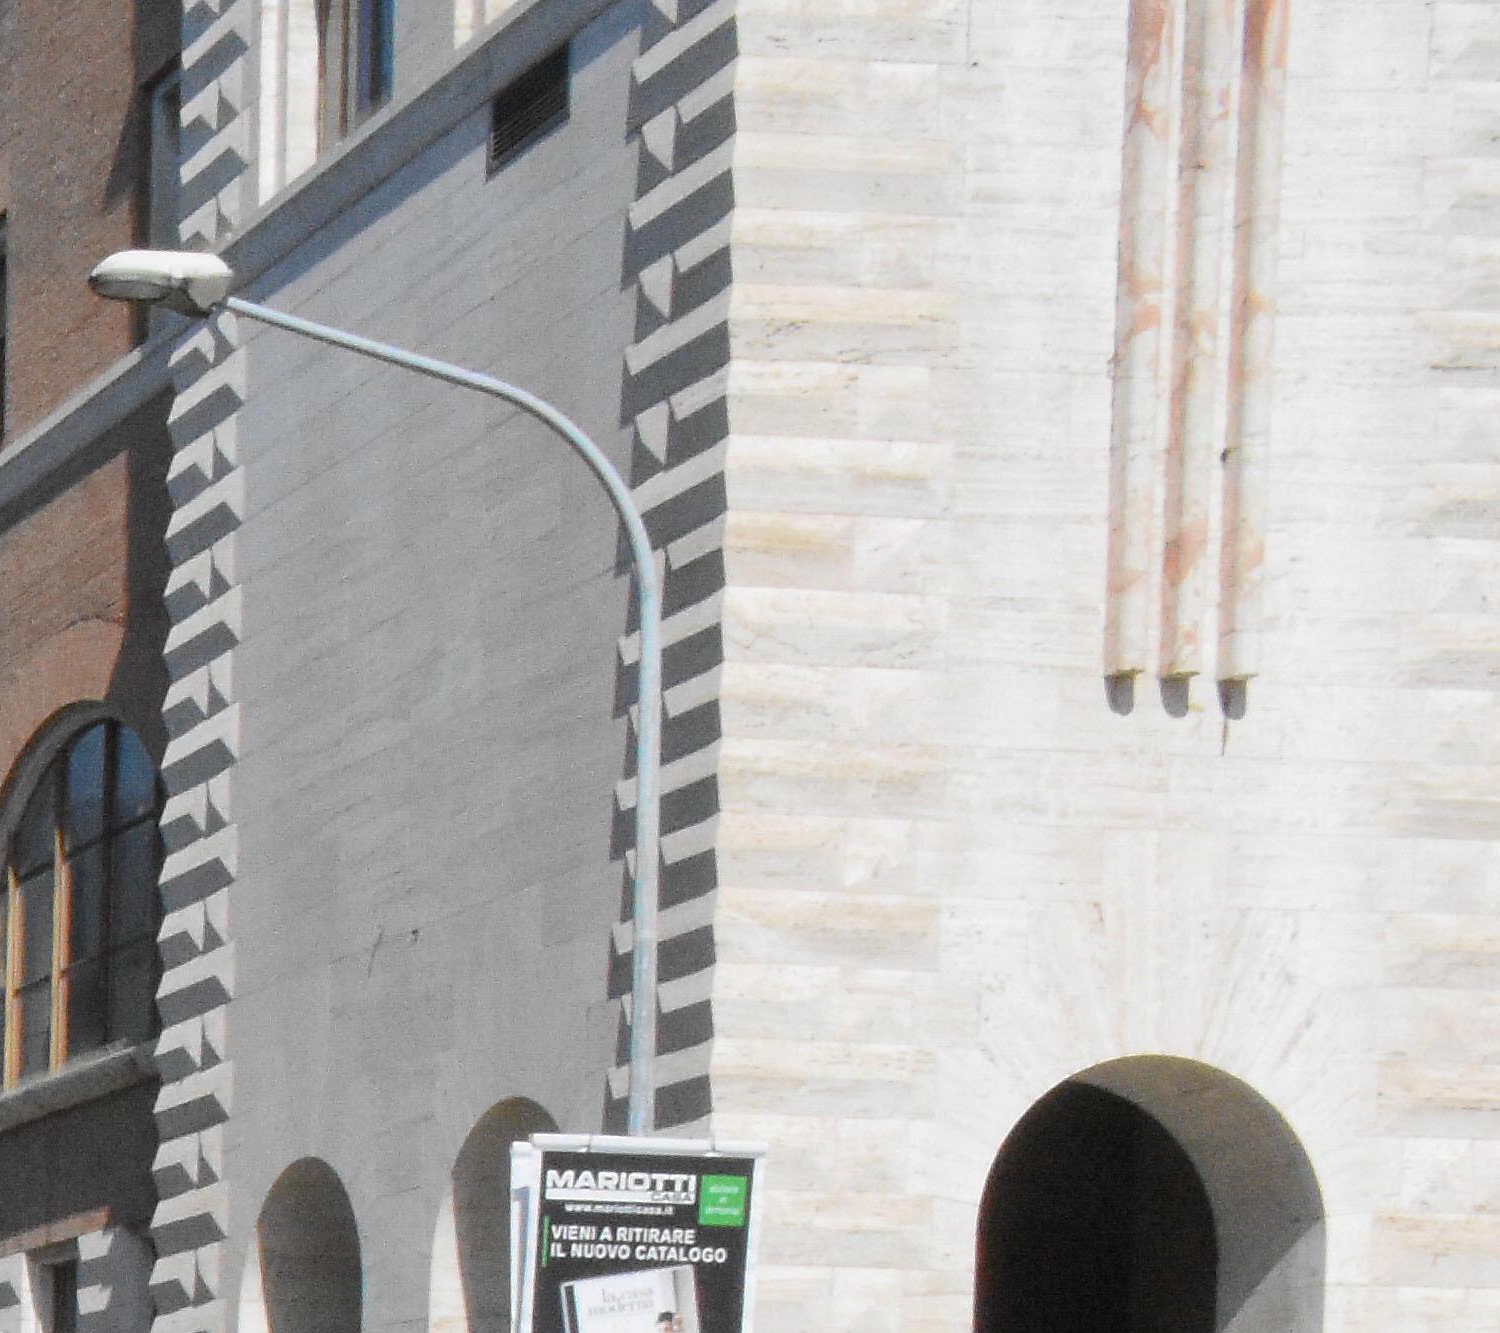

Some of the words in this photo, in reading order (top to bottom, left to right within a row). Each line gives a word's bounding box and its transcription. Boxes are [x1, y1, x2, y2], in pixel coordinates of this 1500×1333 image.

[546, 1169, 697, 1191] MARIOTTI
[551, 1225, 596, 1241] VIENI
[600, 1226, 613, 1242] A
[616, 1227, 696, 1245] RITIRARE
[550, 1244, 566, 1258] IL
[570, 1245, 630, 1260] NUOVO
[634, 1247, 727, 1263] CATALOGO
